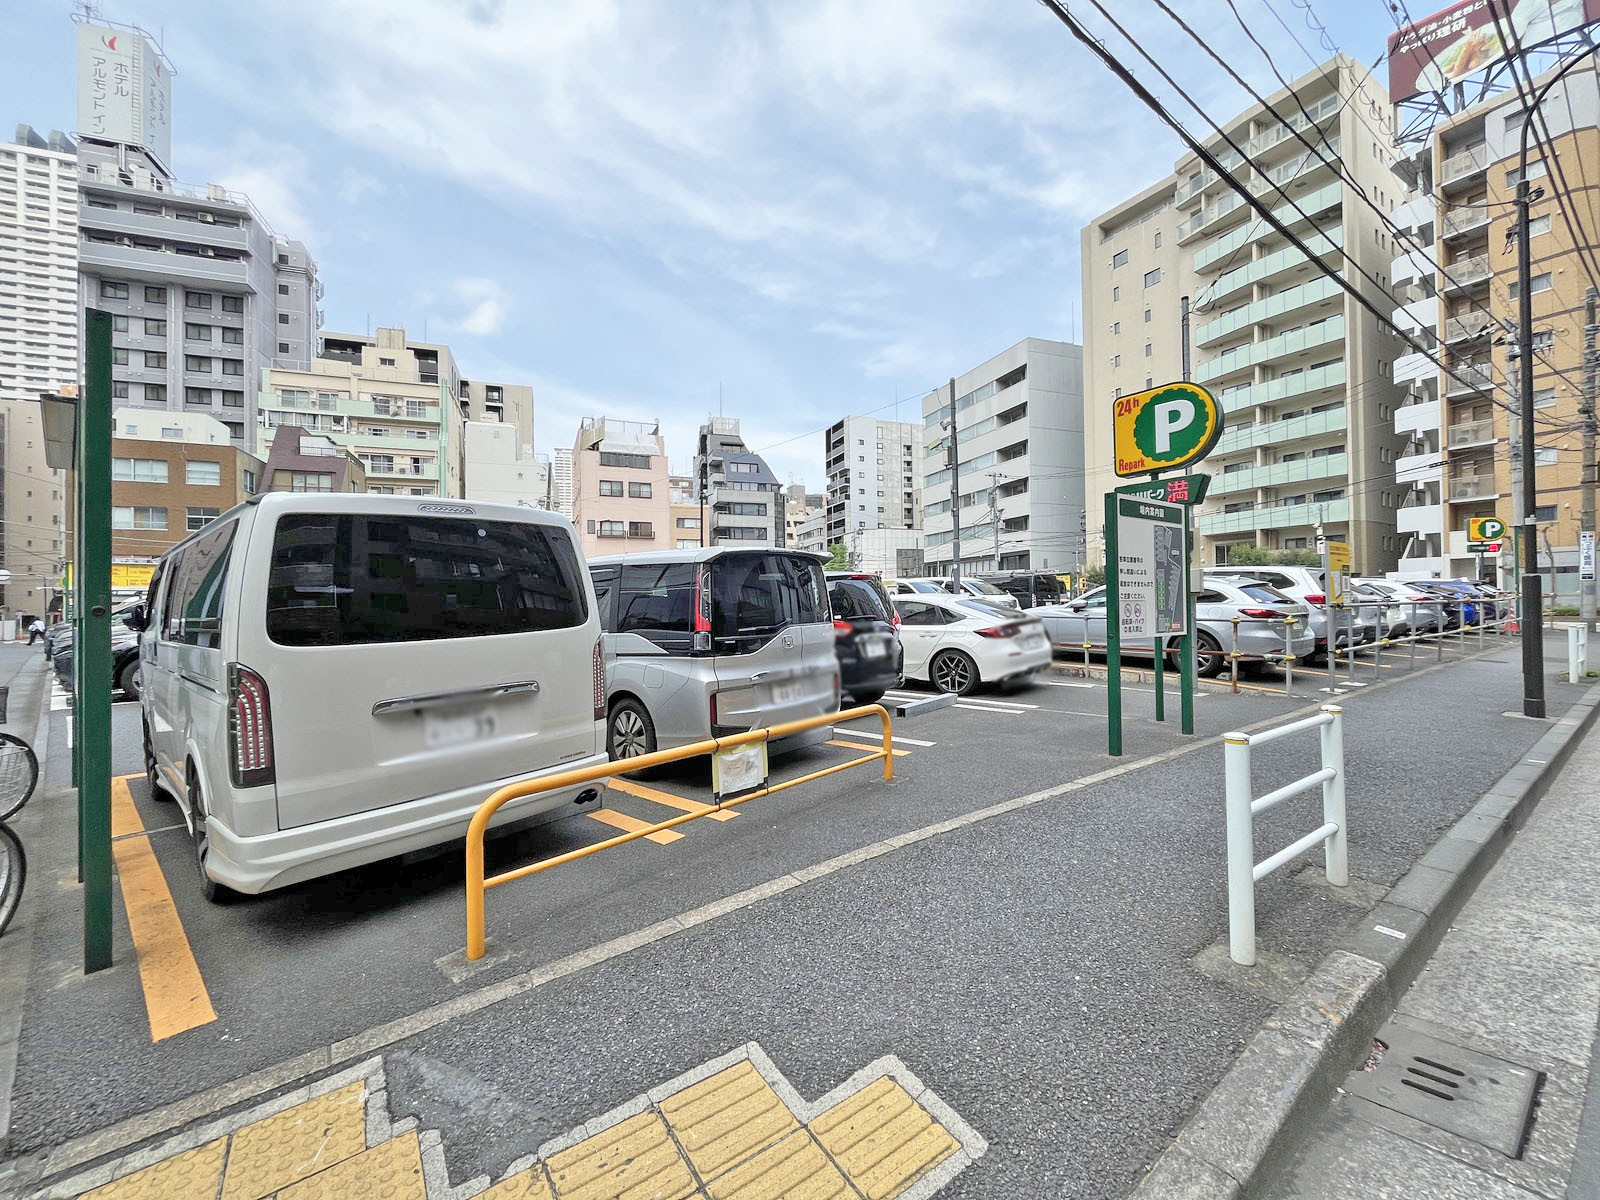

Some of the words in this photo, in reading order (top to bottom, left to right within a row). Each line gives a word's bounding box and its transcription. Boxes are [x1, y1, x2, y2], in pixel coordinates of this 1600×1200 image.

[1399, 17, 1467, 54] やっぱり理研
[113, 62, 129, 97] ホテル
[1117, 398, 1139, 417] 24h
[1154, 399, 1196, 454] P
[1118, 457, 1146, 472] Repark
[1168, 480, 1189, 502] 満
[1485, 521, 1501, 538] P
